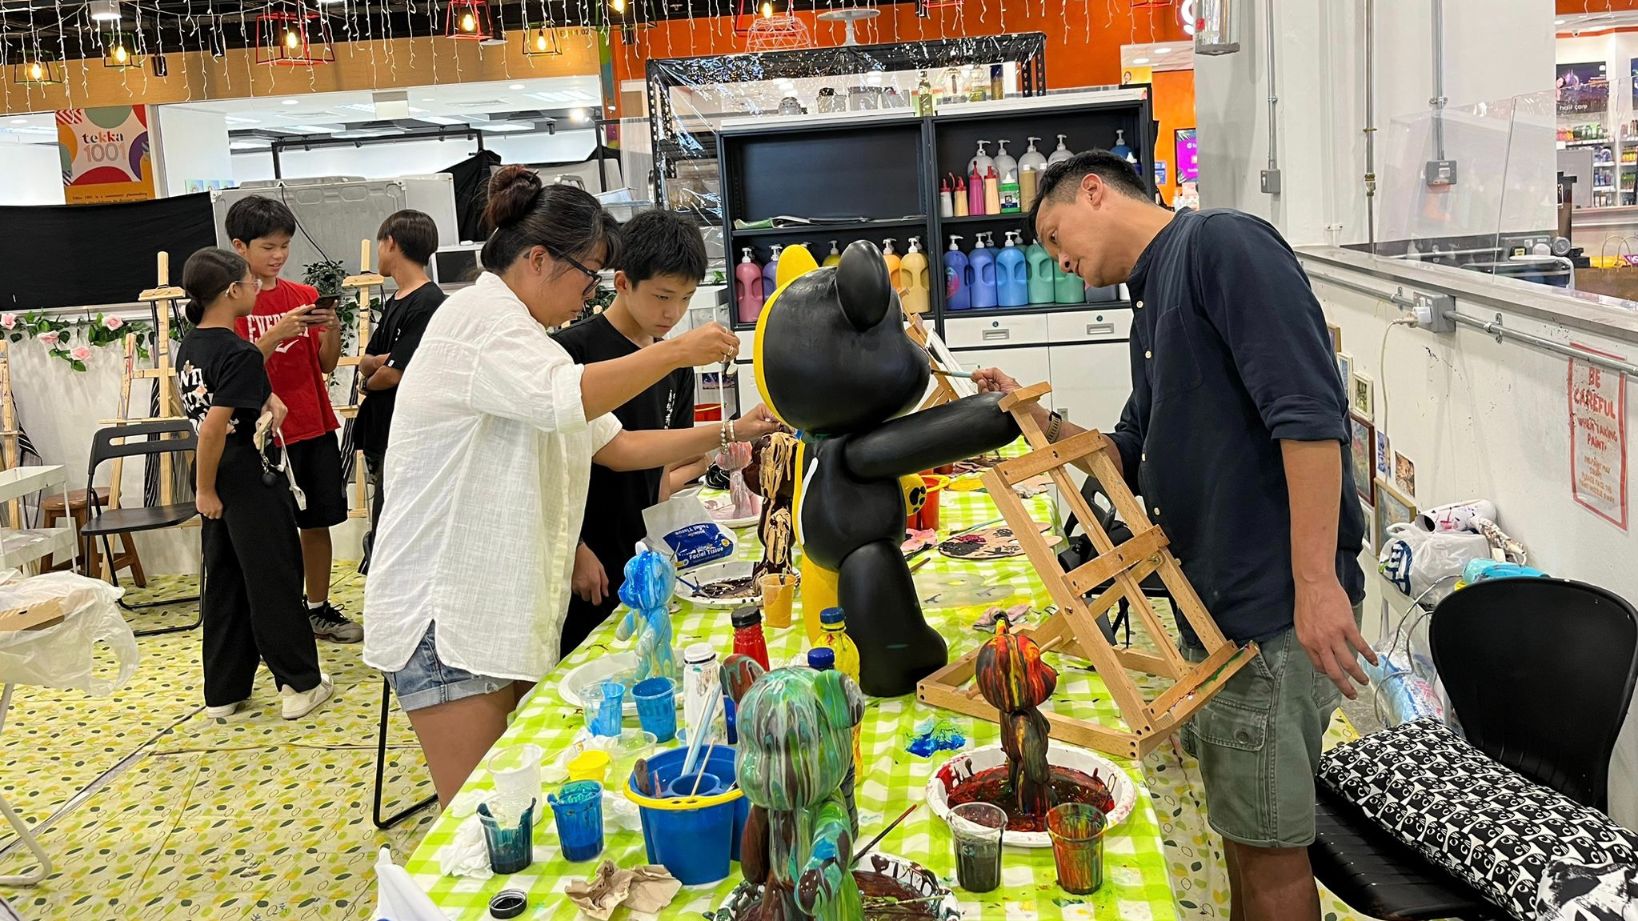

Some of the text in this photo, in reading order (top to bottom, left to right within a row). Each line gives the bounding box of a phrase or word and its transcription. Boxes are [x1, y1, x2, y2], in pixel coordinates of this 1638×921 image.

[82, 131, 123, 144] tekka
[83, 143, 126, 162] 1001
[1588, 367, 1601, 388] BE
[1574, 388, 1616, 420] CAREFUL
[689, 552, 707, 560] Facial
[707, 547, 724, 556] Tissue
